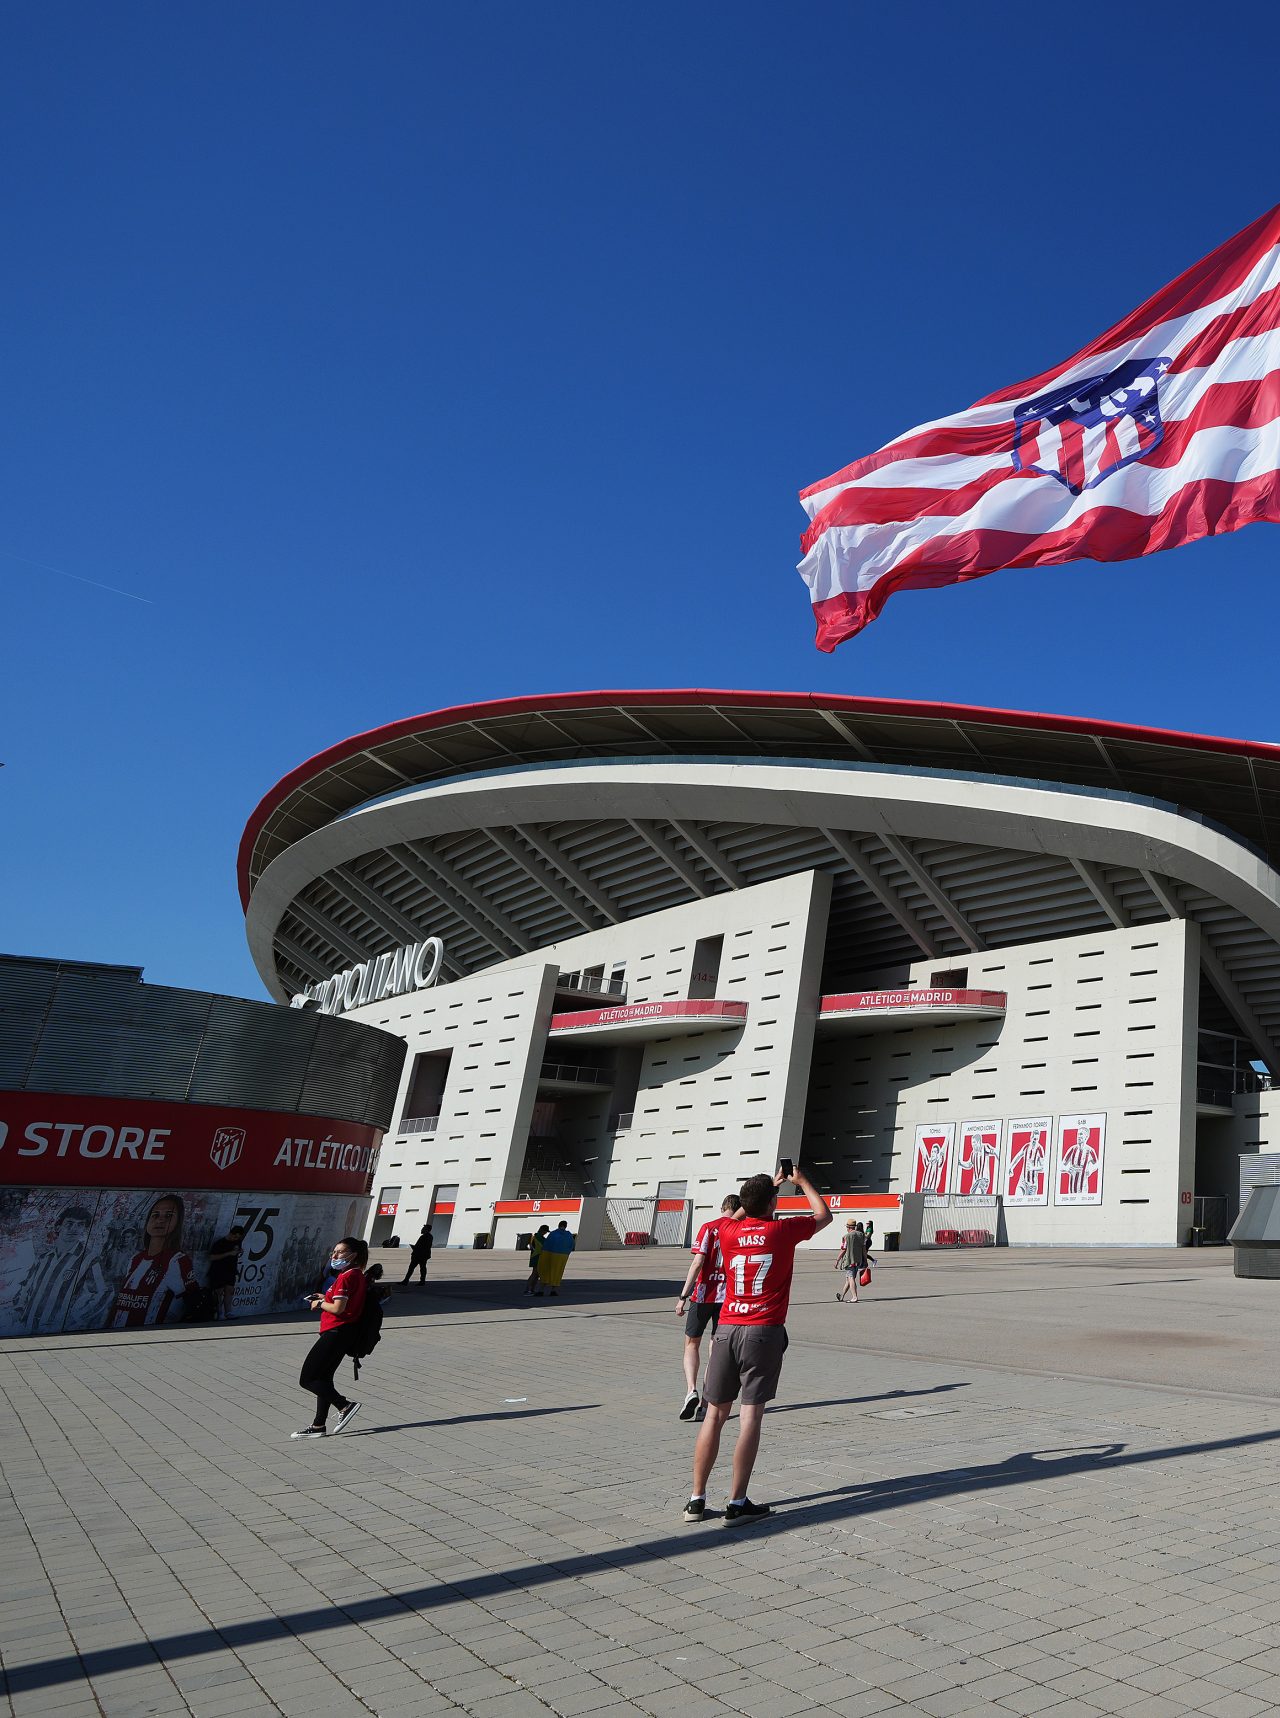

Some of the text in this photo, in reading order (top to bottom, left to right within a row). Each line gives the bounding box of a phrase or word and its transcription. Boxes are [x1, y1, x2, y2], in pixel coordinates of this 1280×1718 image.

[859, 993, 902, 1006] ATLÉTICO
[911, 992, 953, 1003] MADRID
[598, 1009, 629, 1021] ATLÉTICO
[634, 1004, 663, 1017] MADRID
[17, 1121, 172, 1161] STORE
[273, 1134, 360, 1172] ATLÉTICO
[830, 1195, 842, 1208] 04
[1181, 1191, 1192, 1205] 03
[387, 1204, 395, 1214] 06
[532, 1200, 542, 1212] 05
[235, 1207, 280, 1262] 75
[737, 1234, 766, 1247] WASS
[708, 1270, 725, 1281] ria
[729, 1253, 773, 1296] 17
[728, 1299, 750, 1314] ria
